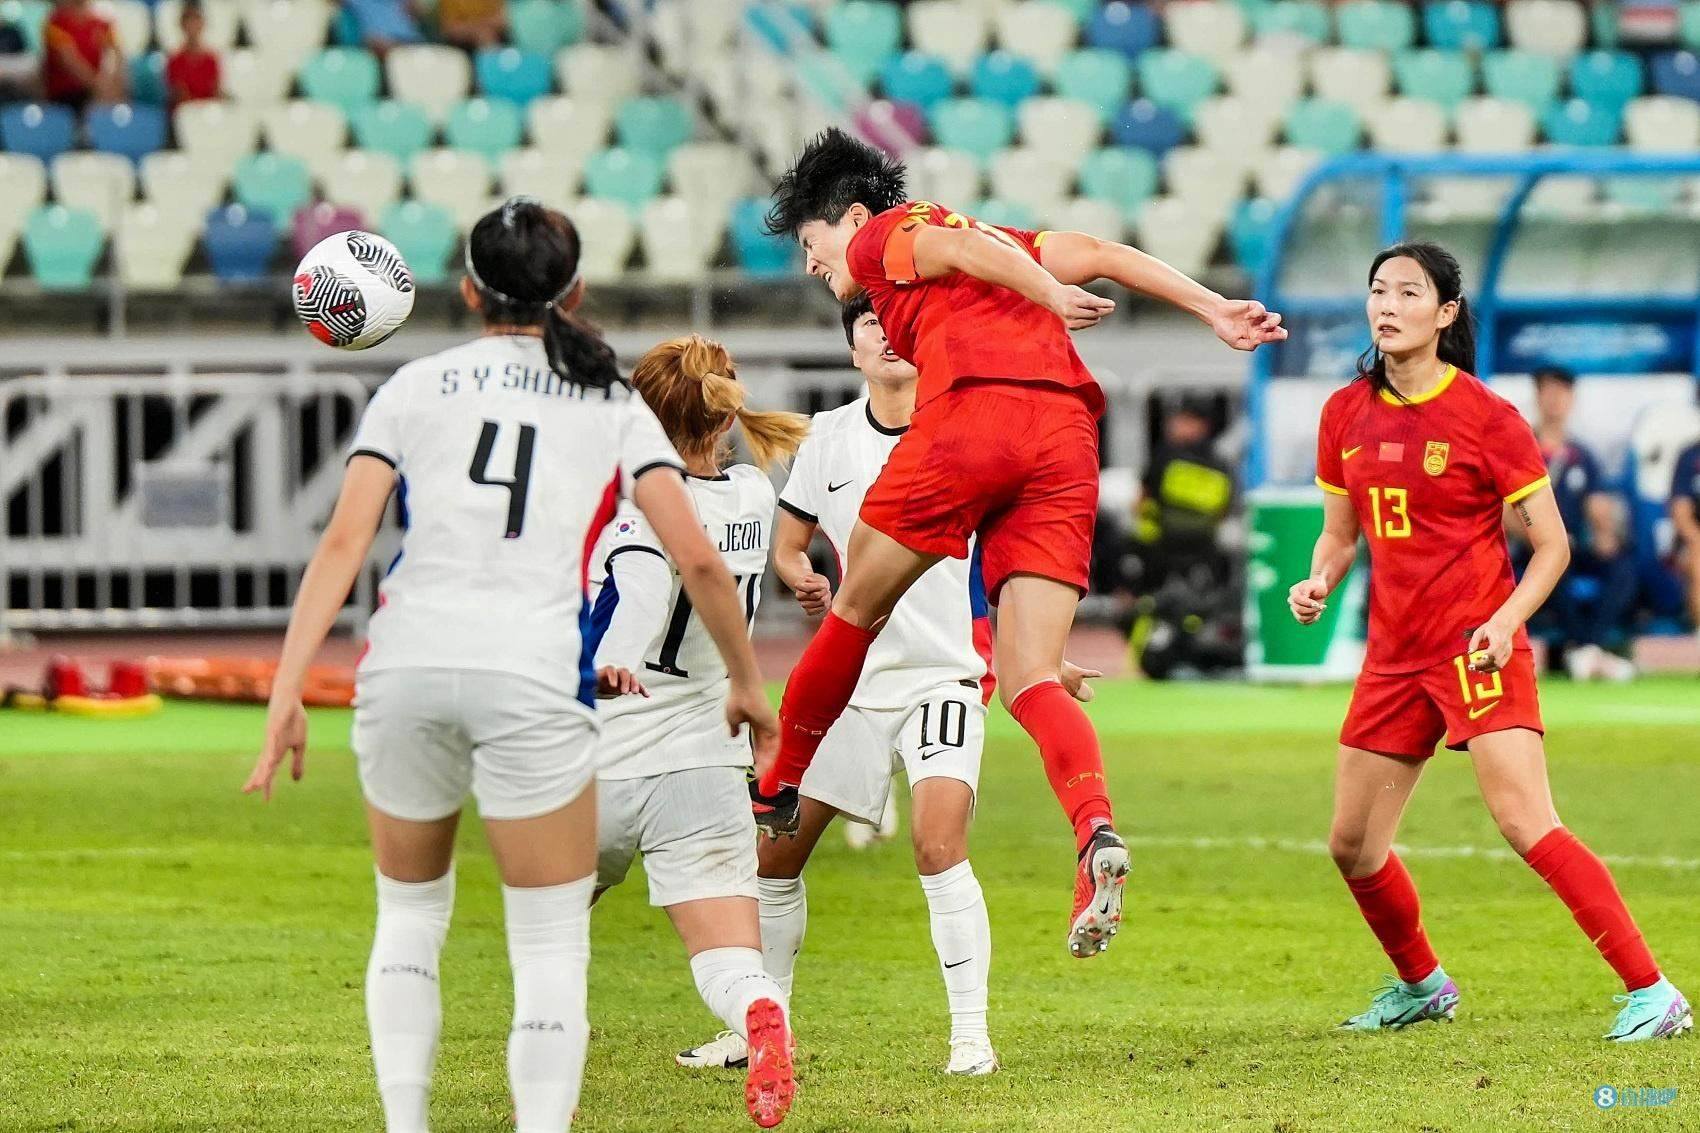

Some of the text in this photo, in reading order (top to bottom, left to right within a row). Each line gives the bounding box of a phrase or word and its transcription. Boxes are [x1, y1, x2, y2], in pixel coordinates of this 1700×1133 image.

[442, 369, 458, 394] S
[474, 366, 490, 391] Y
[469, 421, 536, 538] 4
[719, 520, 761, 552] JEON
[1368, 487, 1412, 538] 13
[917, 699, 967, 750] 10
